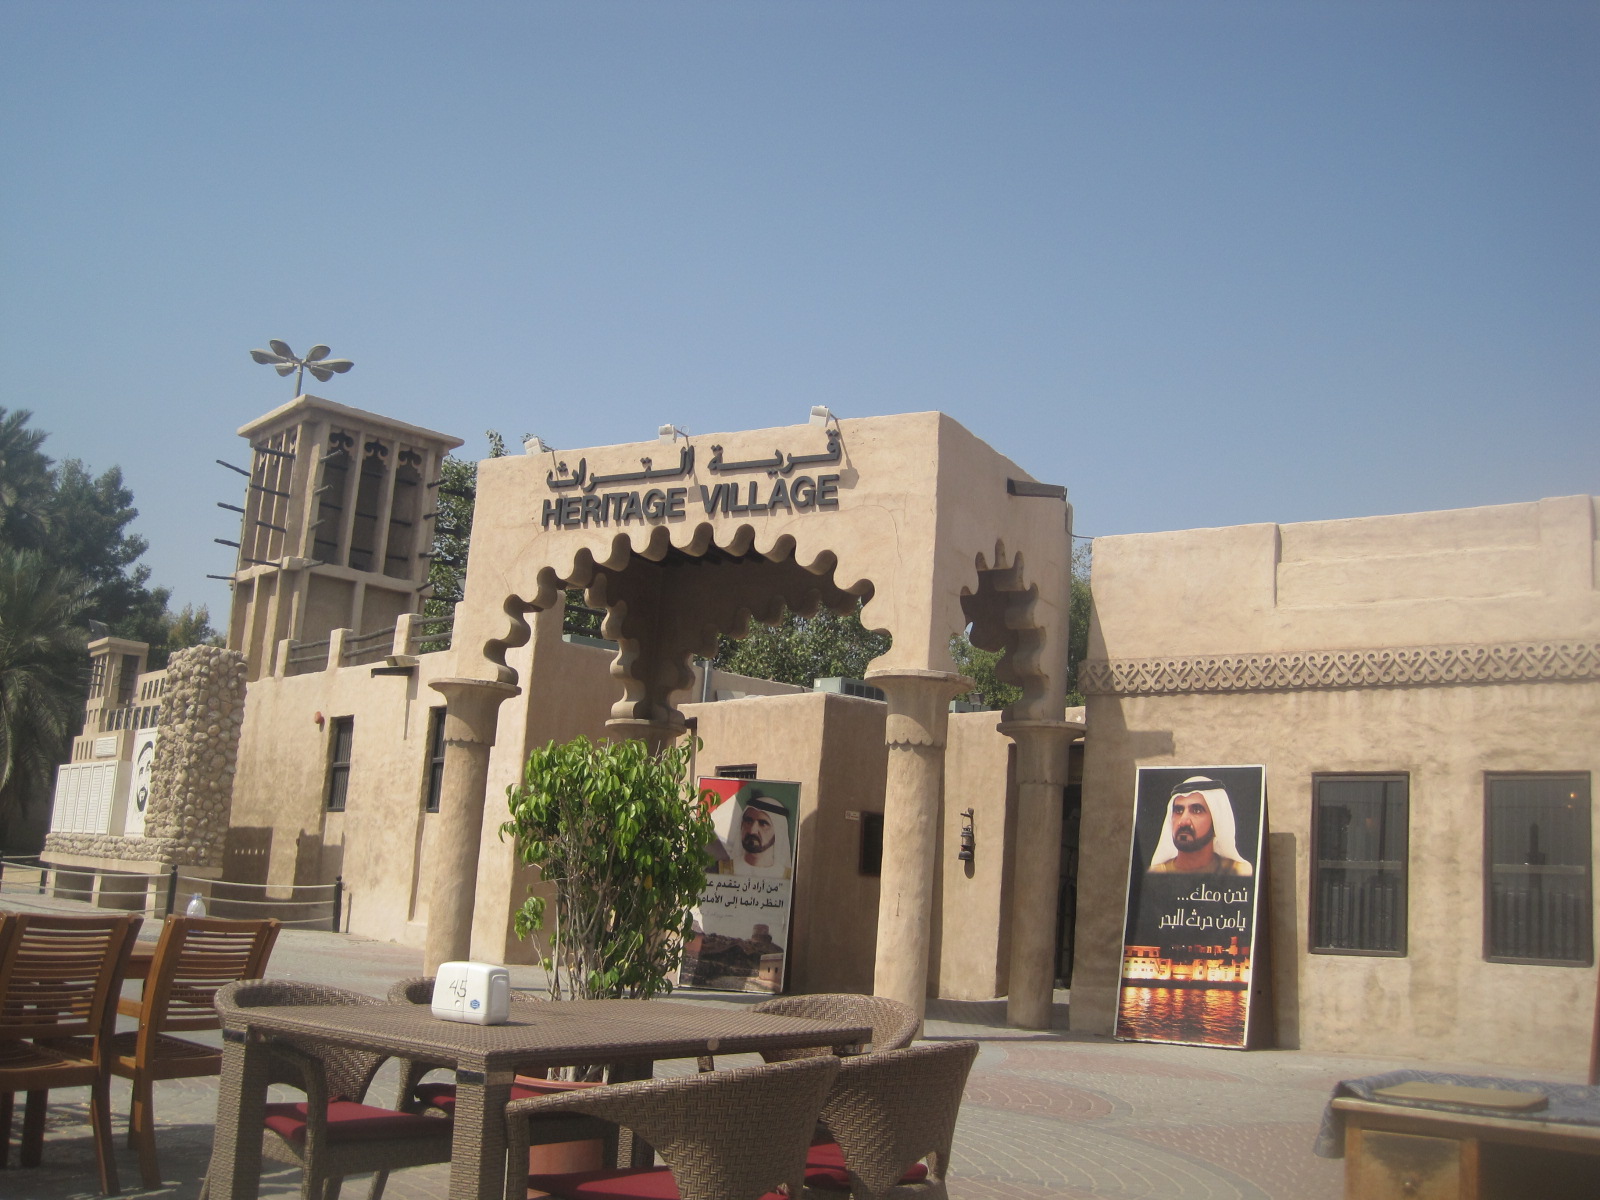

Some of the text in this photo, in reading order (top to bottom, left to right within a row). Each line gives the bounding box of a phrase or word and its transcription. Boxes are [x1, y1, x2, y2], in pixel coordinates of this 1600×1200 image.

[546, 429, 841, 492] قرية التراث
[541, 474, 840, 526] HERITAGE VILLAGE
[716, 879, 740, 891] يتقدم
[742, 878, 751, 892] أن
[753, 879, 765, 893] أراد
[725, 896, 738, 908] إلى
[760, 898, 784, 910] النظر
[1223, 887, 1248, 904] نحن
[1158, 908, 1184, 929] البحر
[1185, 909, 1213, 931] حرث
[449, 979, 467, 998] 45
